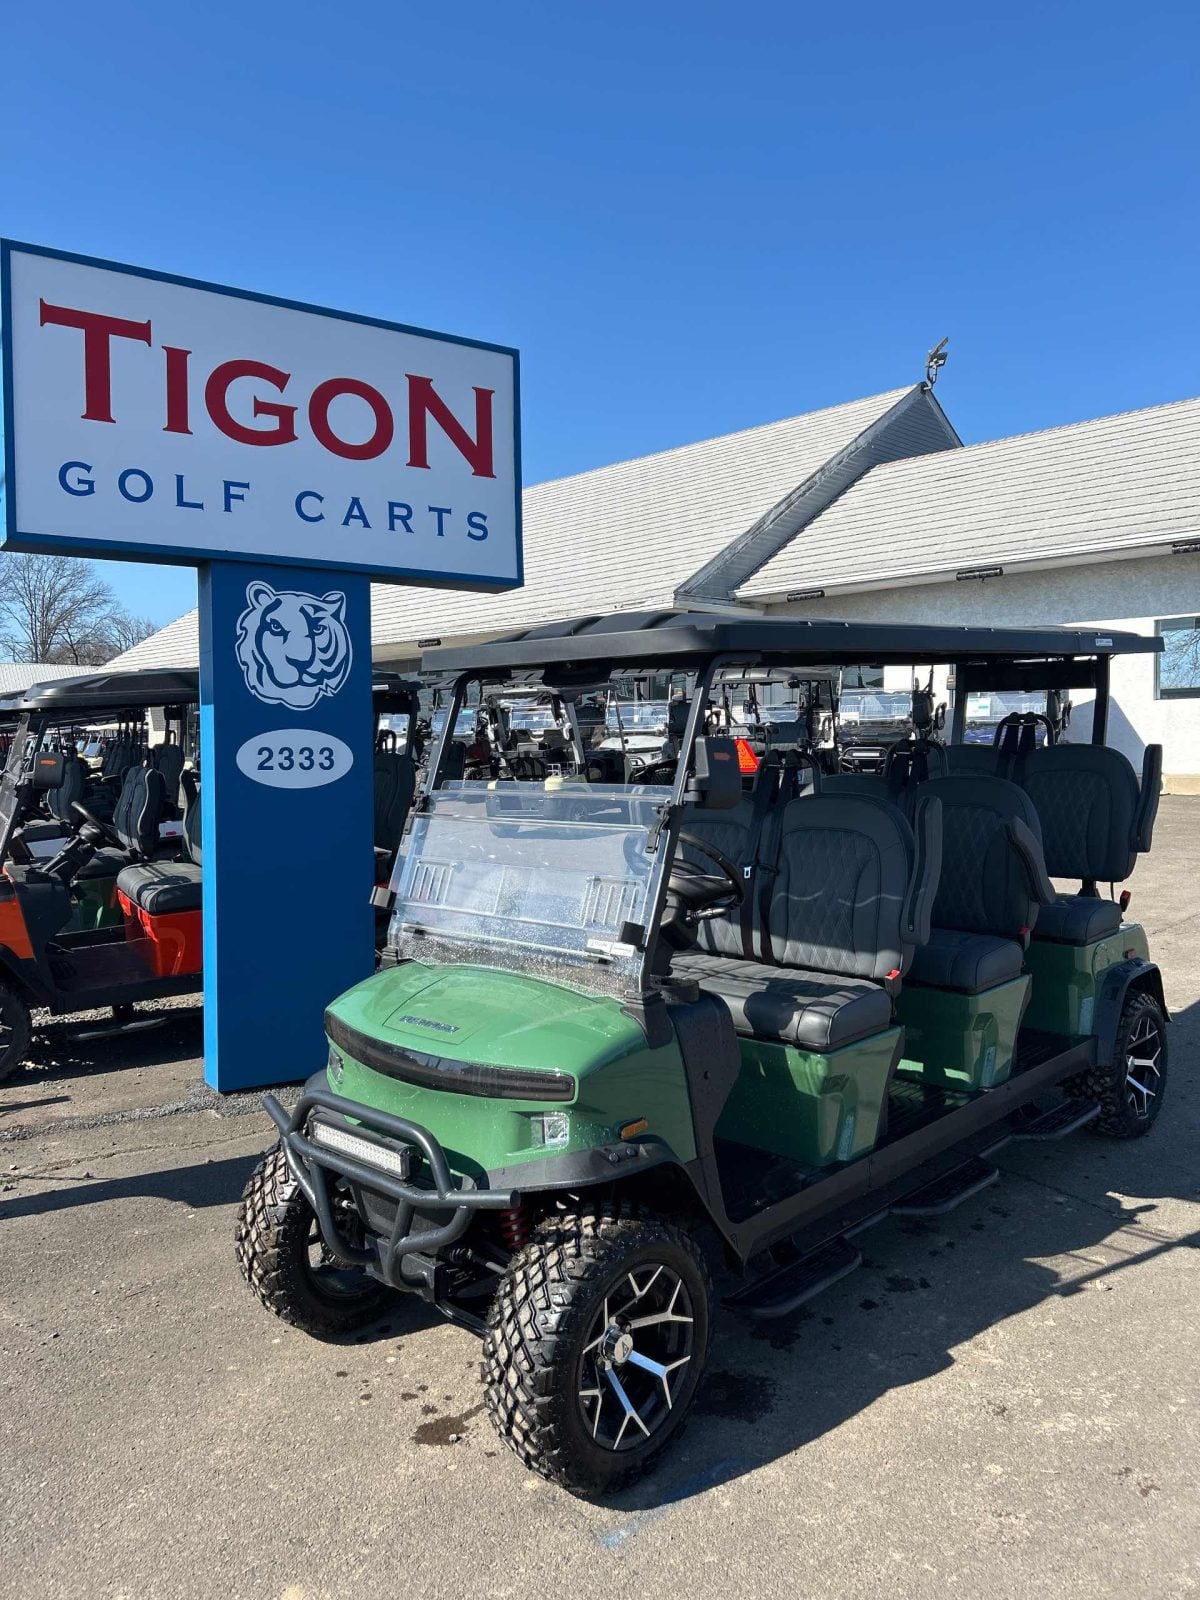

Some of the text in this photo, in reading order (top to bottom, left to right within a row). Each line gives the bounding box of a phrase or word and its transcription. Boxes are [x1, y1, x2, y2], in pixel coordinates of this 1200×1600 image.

[40, 298, 495, 478] TIGON
[58, 460, 489, 542] GOLF CARTS
[257, 746, 335, 771] 2333
